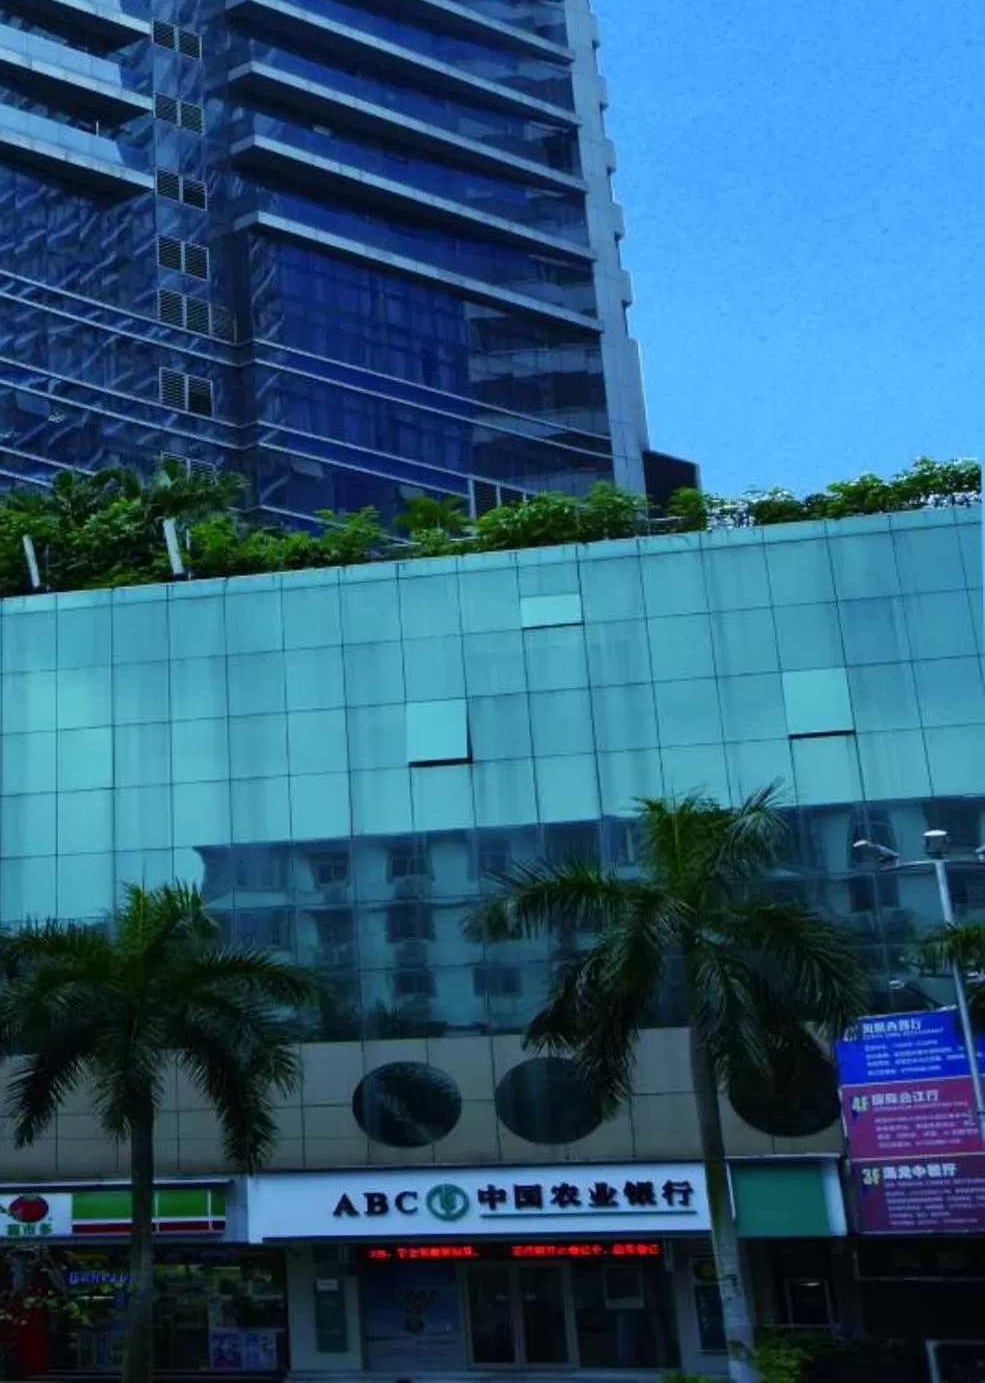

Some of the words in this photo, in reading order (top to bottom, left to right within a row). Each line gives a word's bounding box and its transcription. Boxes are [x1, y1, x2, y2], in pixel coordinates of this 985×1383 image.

[332, 1191, 419, 1217] ABC
[477, 1180, 695, 1211] 中国农业银行
